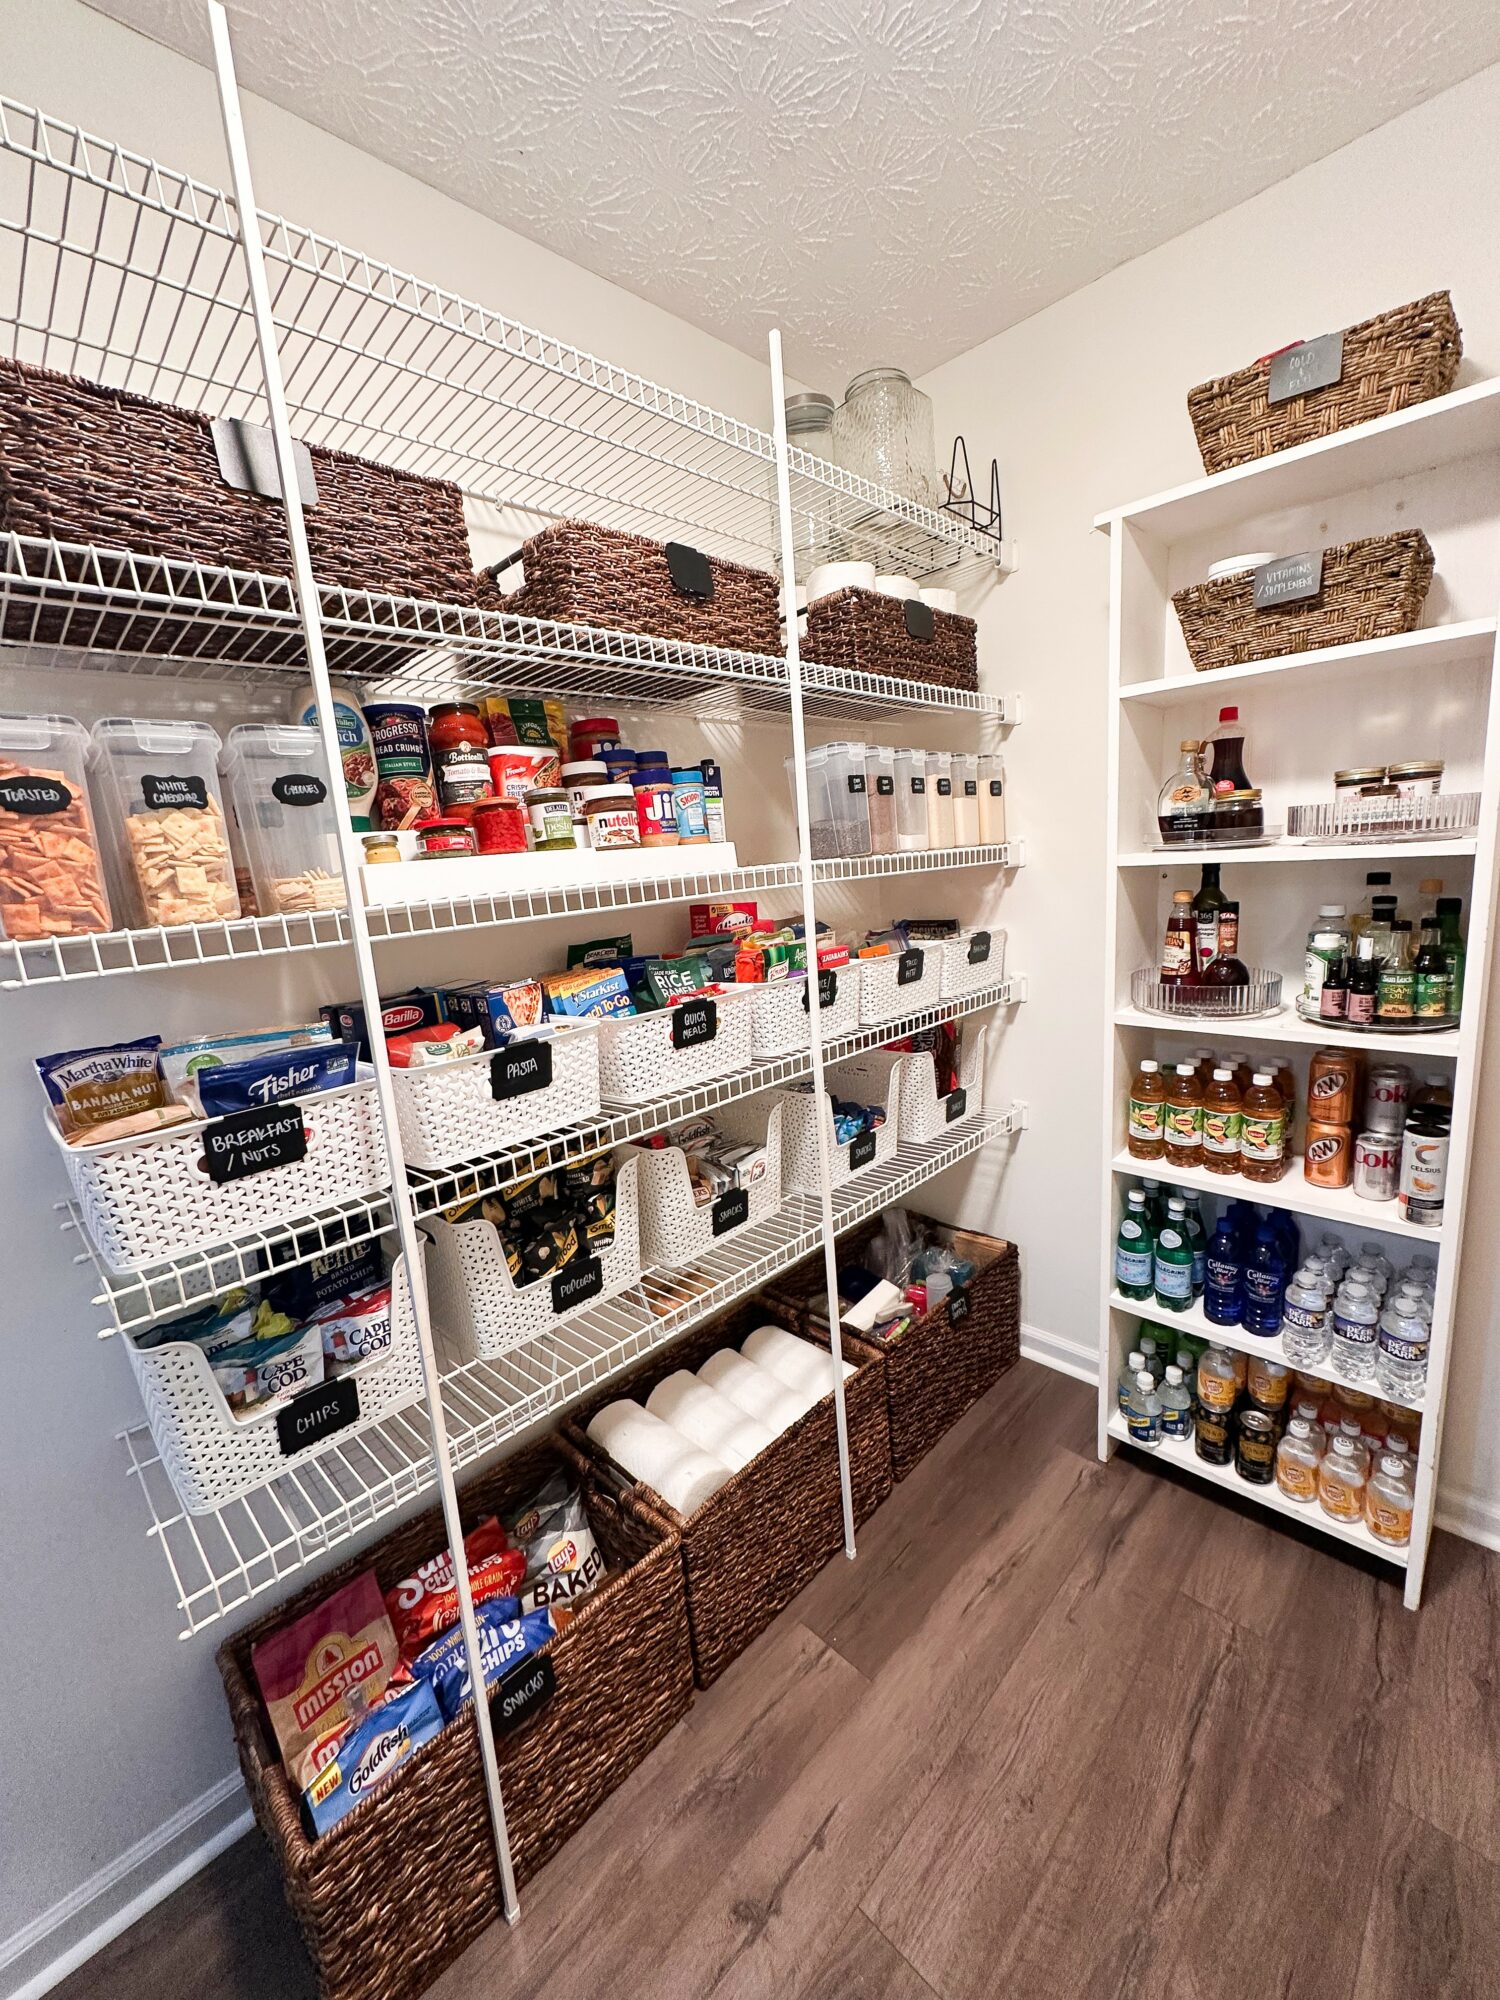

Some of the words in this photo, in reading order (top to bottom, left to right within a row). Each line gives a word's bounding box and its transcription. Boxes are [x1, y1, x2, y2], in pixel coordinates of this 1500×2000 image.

[1266, 563, 1313, 584] VITAMINS
[372, 723, 419, 741] PROGRESSO
[375, 745, 394, 755] READ
[395, 743, 425, 754] CRUMBS
[1, 787, 60, 802] TOASTED
[155, 780, 190, 792] WHITE
[654, 970, 694, 989] RICE
[1382, 975, 1396, 983] Sun
[1396, 975, 1414, 983] Luck
[578, 981, 620, 1002] StarKist
[661, 984, 698, 999] RAMEN
[1380, 986, 1413, 994] SESAME
[600, 994, 631, 1014] To-Go
[383, 1009, 420, 1027] Barilla
[684, 1010, 707, 1026] QUICK
[682, 1023, 707, 1040] MEALS
[58, 1062, 113, 1089] Martha
[111, 1054, 152, 1070] White
[506, 1057, 538, 1080] PASTA
[248, 1063, 320, 1104] Fisher
[71, 1090, 130, 1111] BANANA
[131, 1081, 158, 1098] NUT
[211, 1116, 301, 1153] BREAKFAST
[677, 1124, 711, 1145] Goldfish
[241, 1143, 281, 1166] NUTS
[1355, 1143, 1398, 1169] Cok
[1410, 1164, 1442, 1175] CELSIUS
[512, 1194, 534, 1209] WHITE
[330, 1264, 355, 1280] BRAND
[316, 1277, 349, 1299] POTATO
[560, 1271, 596, 1299] POPCORN
[1288, 1314, 1314, 1328] PARK
[1289, 1307, 1313, 1322] DEER
[350, 1318, 391, 1346] CAPE
[1346, 1331, 1373, 1343] PARK
[1347, 1325, 1373, 1337] DEER
[358, 1332, 391, 1357] COD
[1388, 1339, 1416, 1354] DEER
[1388, 1347, 1416, 1360] PARK
[261, 1354, 305, 1381] CAPE
[267, 1367, 308, 1394] COD
[296, 1400, 340, 1434] CHIPS
[533, 1546, 602, 1607] BAKED
[480, 1633, 526, 1675] CHIPS
[502, 1670, 545, 1717] SNACKS
[349, 1724, 409, 1795] Goldfish
[315, 1773, 340, 1801] NEW
